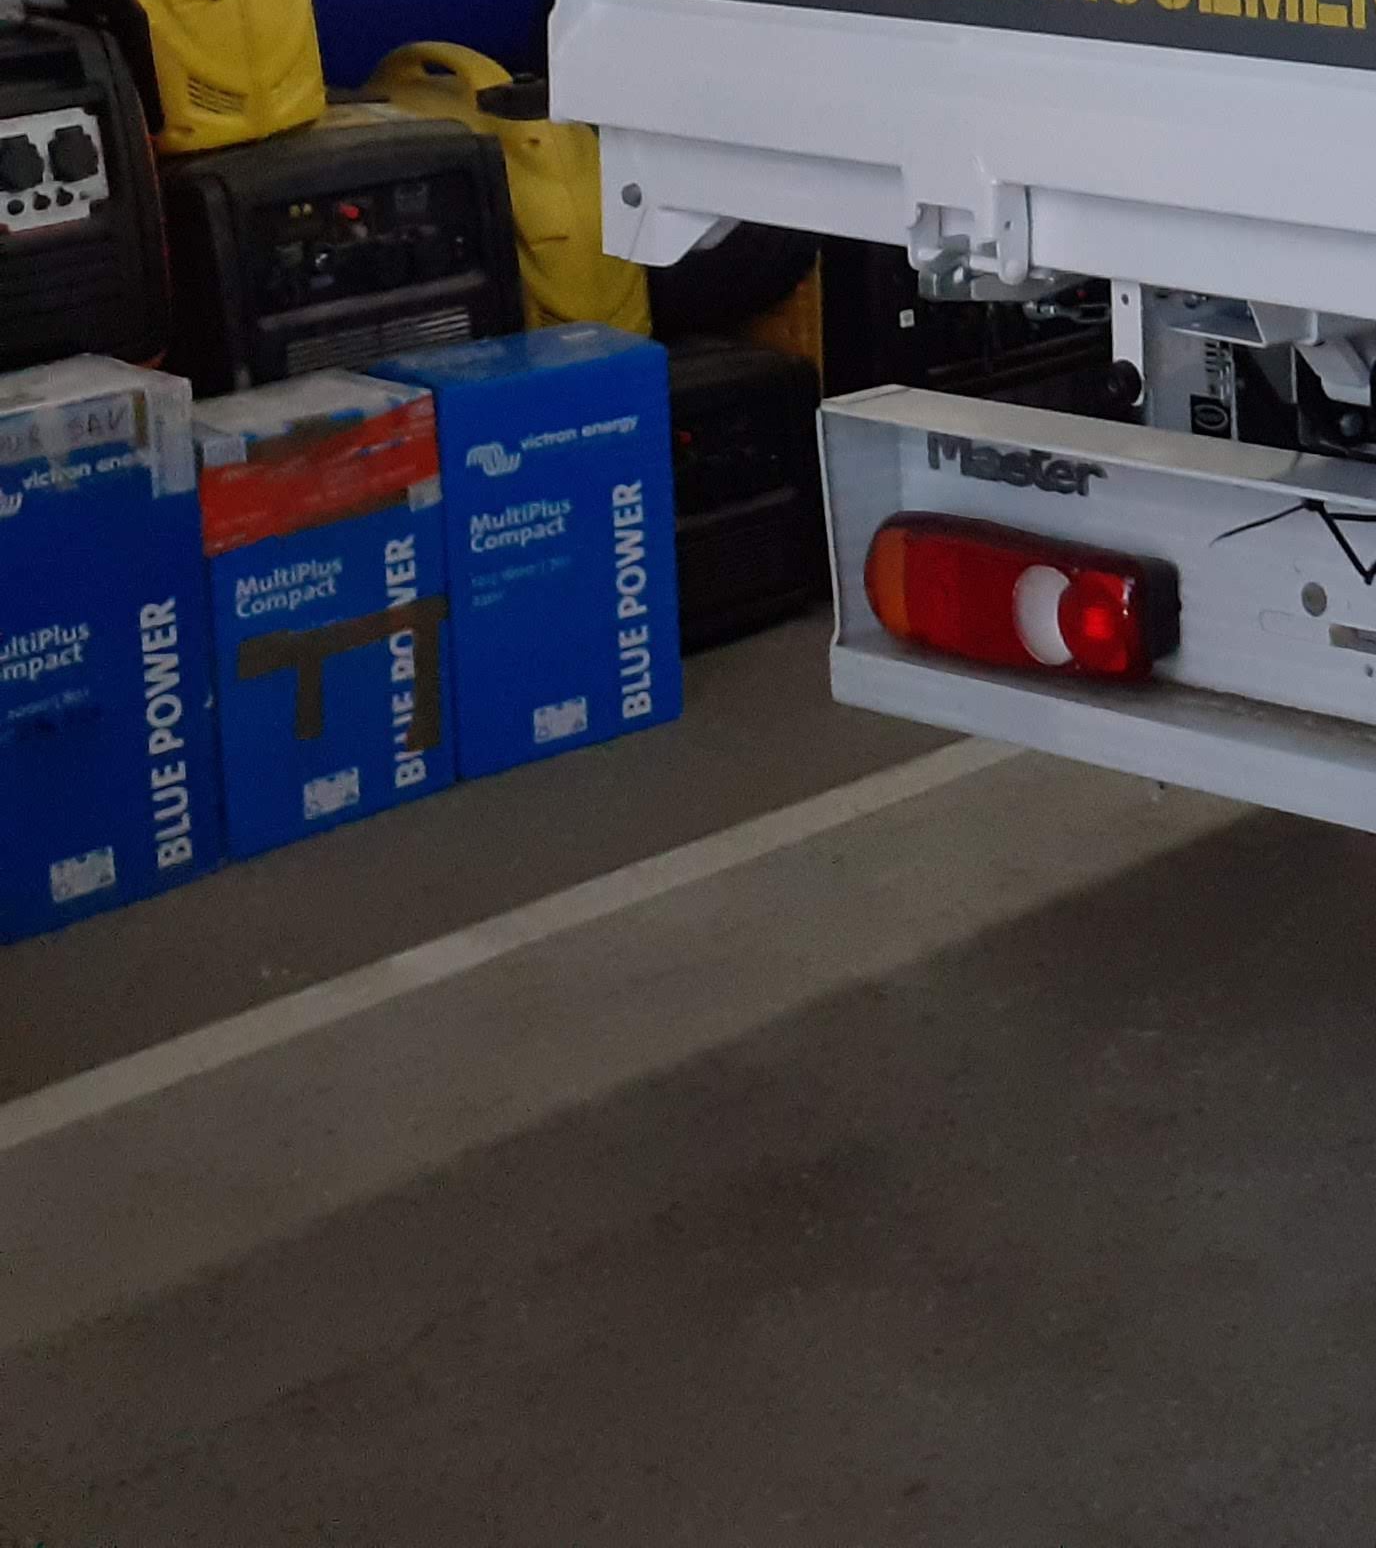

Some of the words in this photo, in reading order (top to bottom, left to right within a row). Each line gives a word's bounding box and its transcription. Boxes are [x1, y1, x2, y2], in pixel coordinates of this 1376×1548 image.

[520, 426, 577, 451] victron
[580, 413, 641, 439] energy
[470, 497, 573, 536] MultiPlus
[470, 515, 565, 553] Compact
[612, 478, 649, 620] POWER
[236, 556, 344, 602] MultiPlus
[236, 576, 338, 618] Compact
[0, 623, 91, 661] ultiPlus
[0, 642, 84, 682] mpact
[140, 595, 185, 756] POWER
[618, 624, 652, 720] BLUE
[151, 760, 193, 870] BLUE
